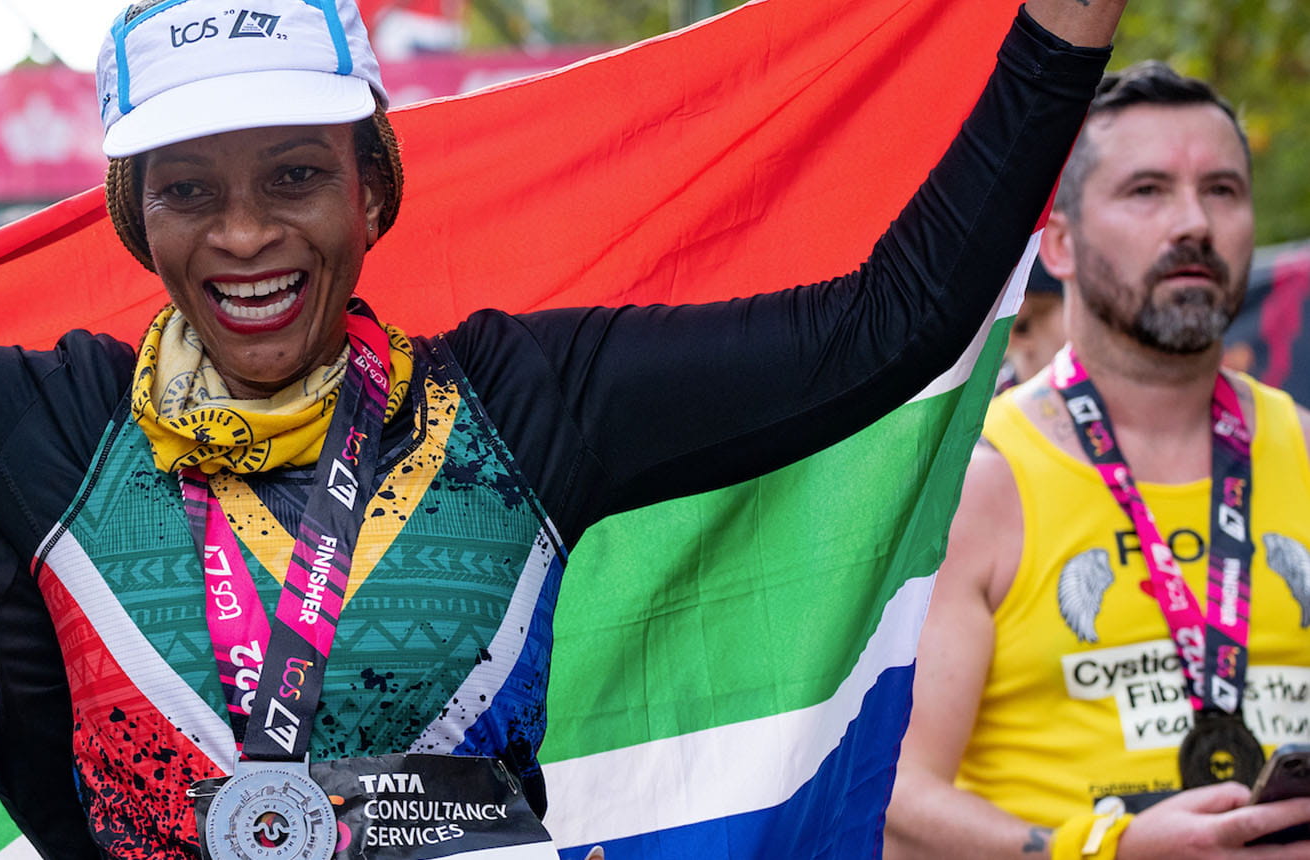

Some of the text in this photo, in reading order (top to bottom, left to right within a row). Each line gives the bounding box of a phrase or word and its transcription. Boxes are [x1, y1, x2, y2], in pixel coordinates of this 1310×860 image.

[170, 17, 219, 48] tcs
[342, 426, 368, 466] tcs
[297, 534, 338, 625] FINISHER
[210, 580, 243, 620] tcs
[278, 657, 314, 701] tcs
[1073, 649, 1182, 690] Cystic
[358, 773, 425, 794] TATA
[363, 799, 508, 821] CONSULTANCY
[366, 823, 465, 847] SERVICES
